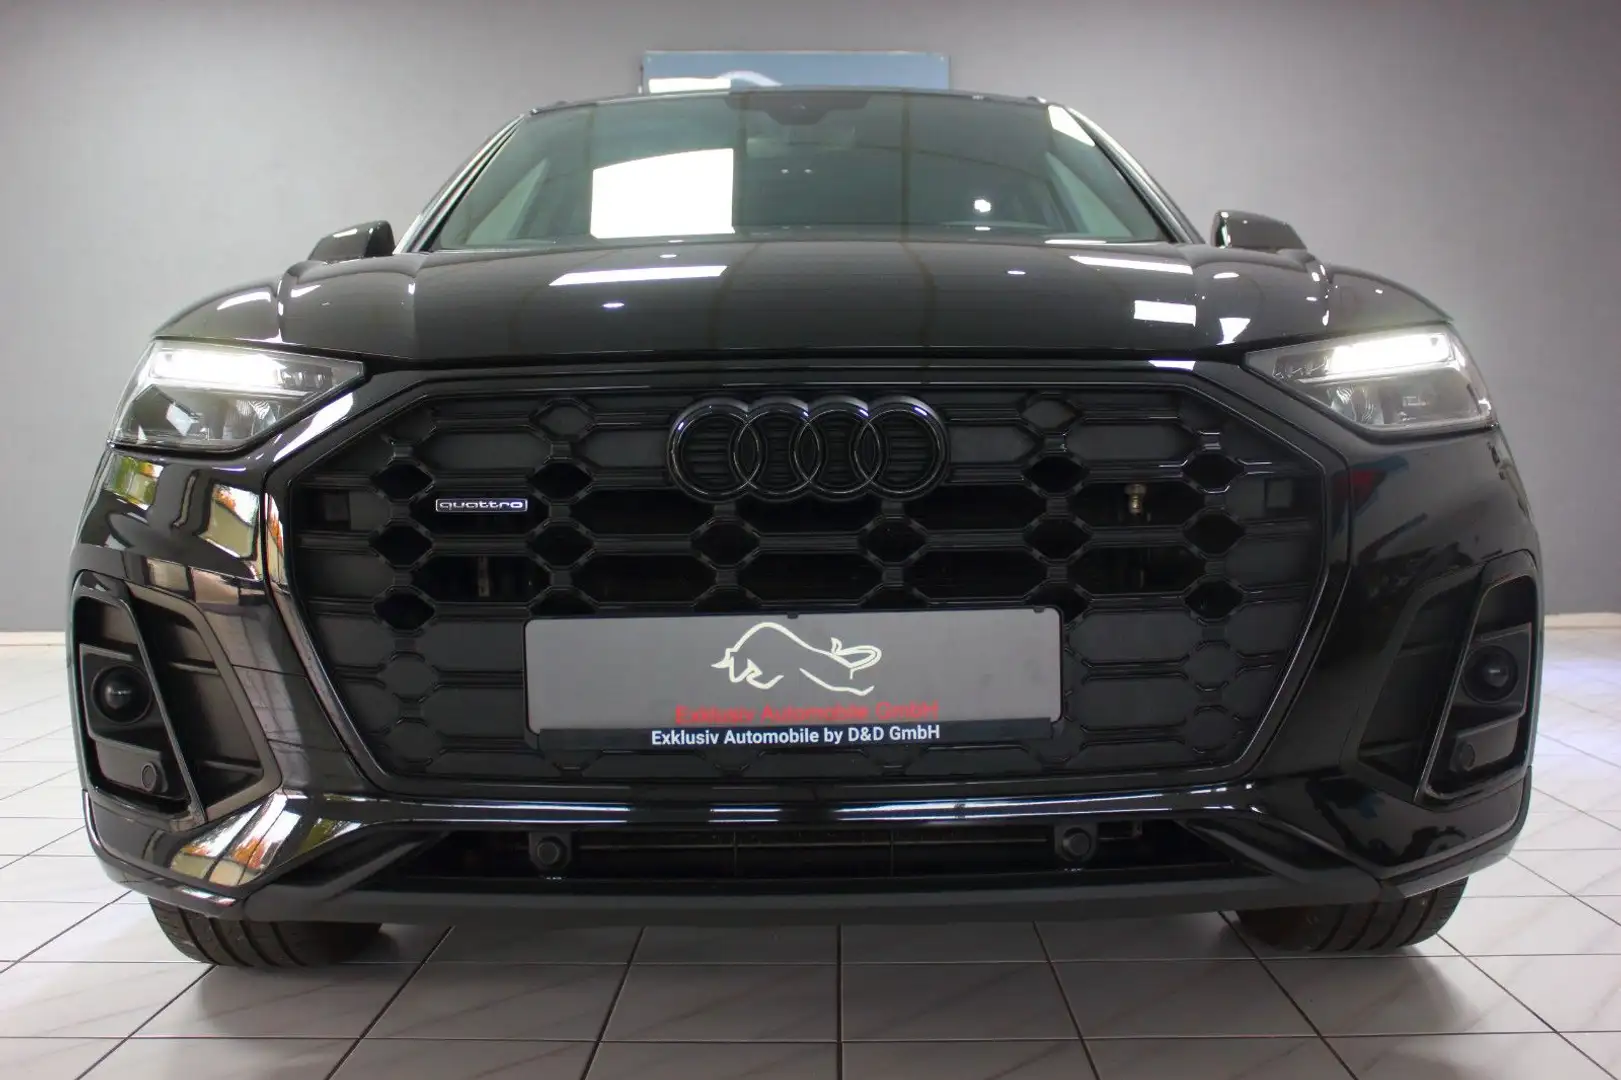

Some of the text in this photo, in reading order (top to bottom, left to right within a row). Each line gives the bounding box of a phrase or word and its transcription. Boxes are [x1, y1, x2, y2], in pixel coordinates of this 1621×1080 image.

[439, 501, 523, 511] quattro
[674, 700, 939, 725] Exklusiv Automobile GmbH
[651, 724, 940, 745] Exklusiv Automobile by D&D GmbH
